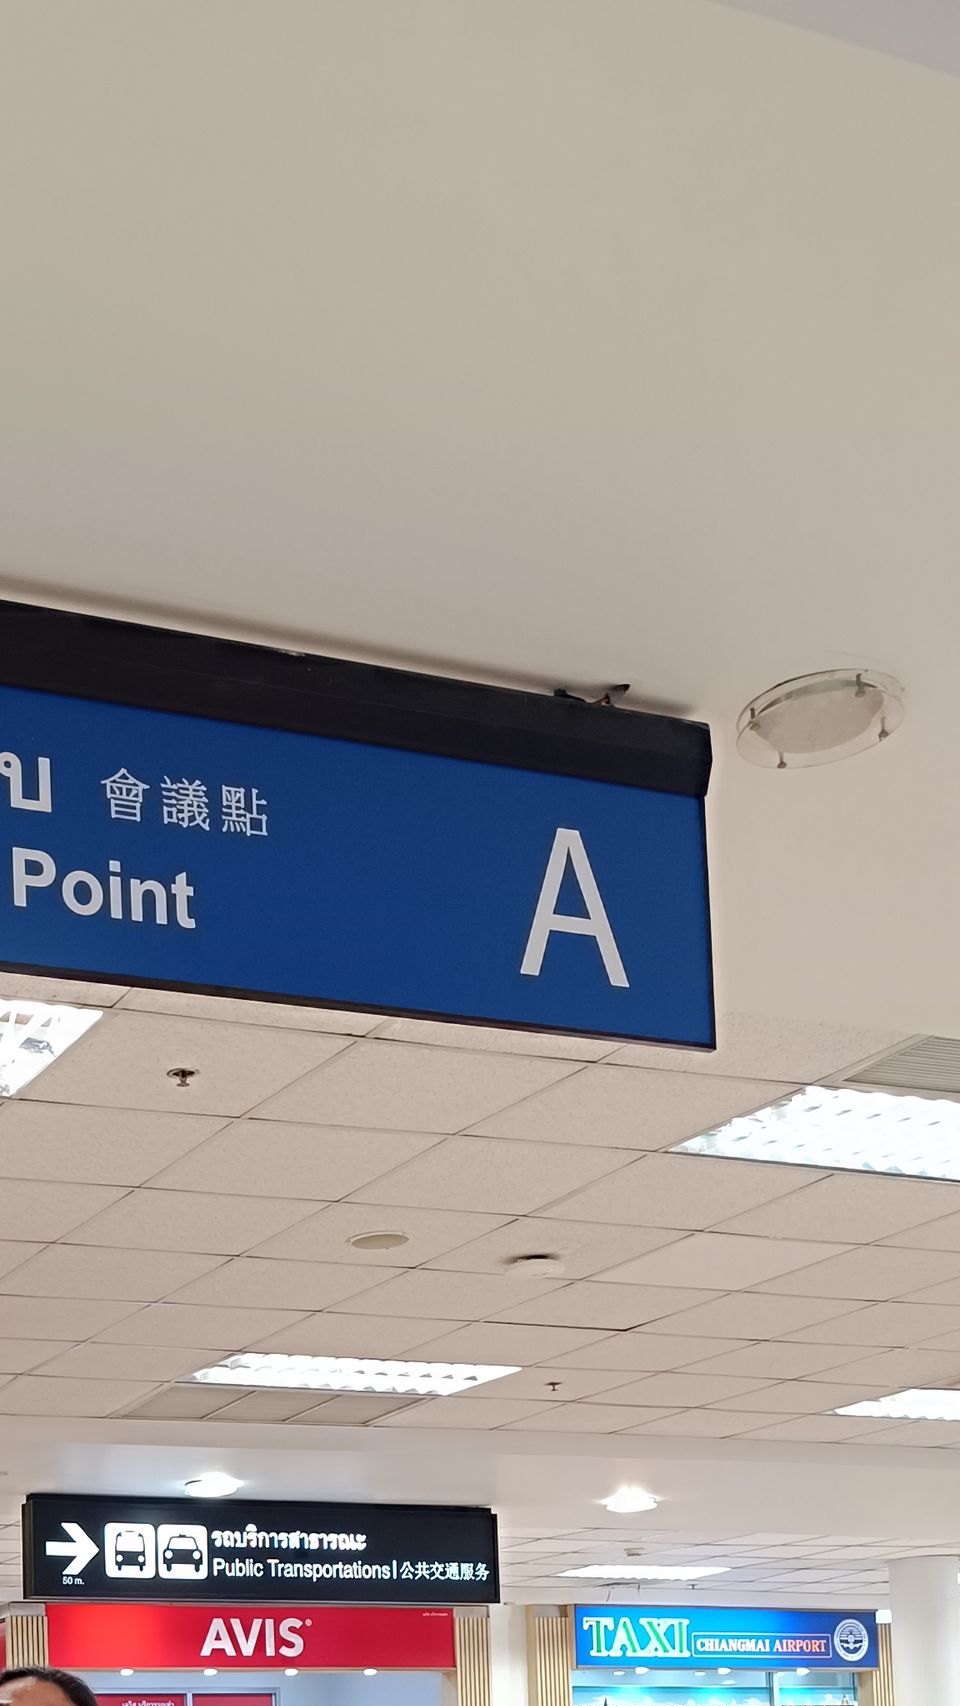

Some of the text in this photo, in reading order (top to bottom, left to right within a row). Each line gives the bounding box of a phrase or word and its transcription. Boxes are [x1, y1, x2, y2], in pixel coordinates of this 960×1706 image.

[100, 767, 269, 838] 會議點
[12, 847, 196, 929] Point
[520, 828, 630, 988] A
[62, 1576, 73, 1585] 50
[212, 1557, 391, 1582] Public Transportations
[399, 1560, 489, 1581] 公共交通服务
[582, 1617, 691, 1658] TAXI
[695, 1637, 827, 1653] CHIANGMAI AIRPORT
